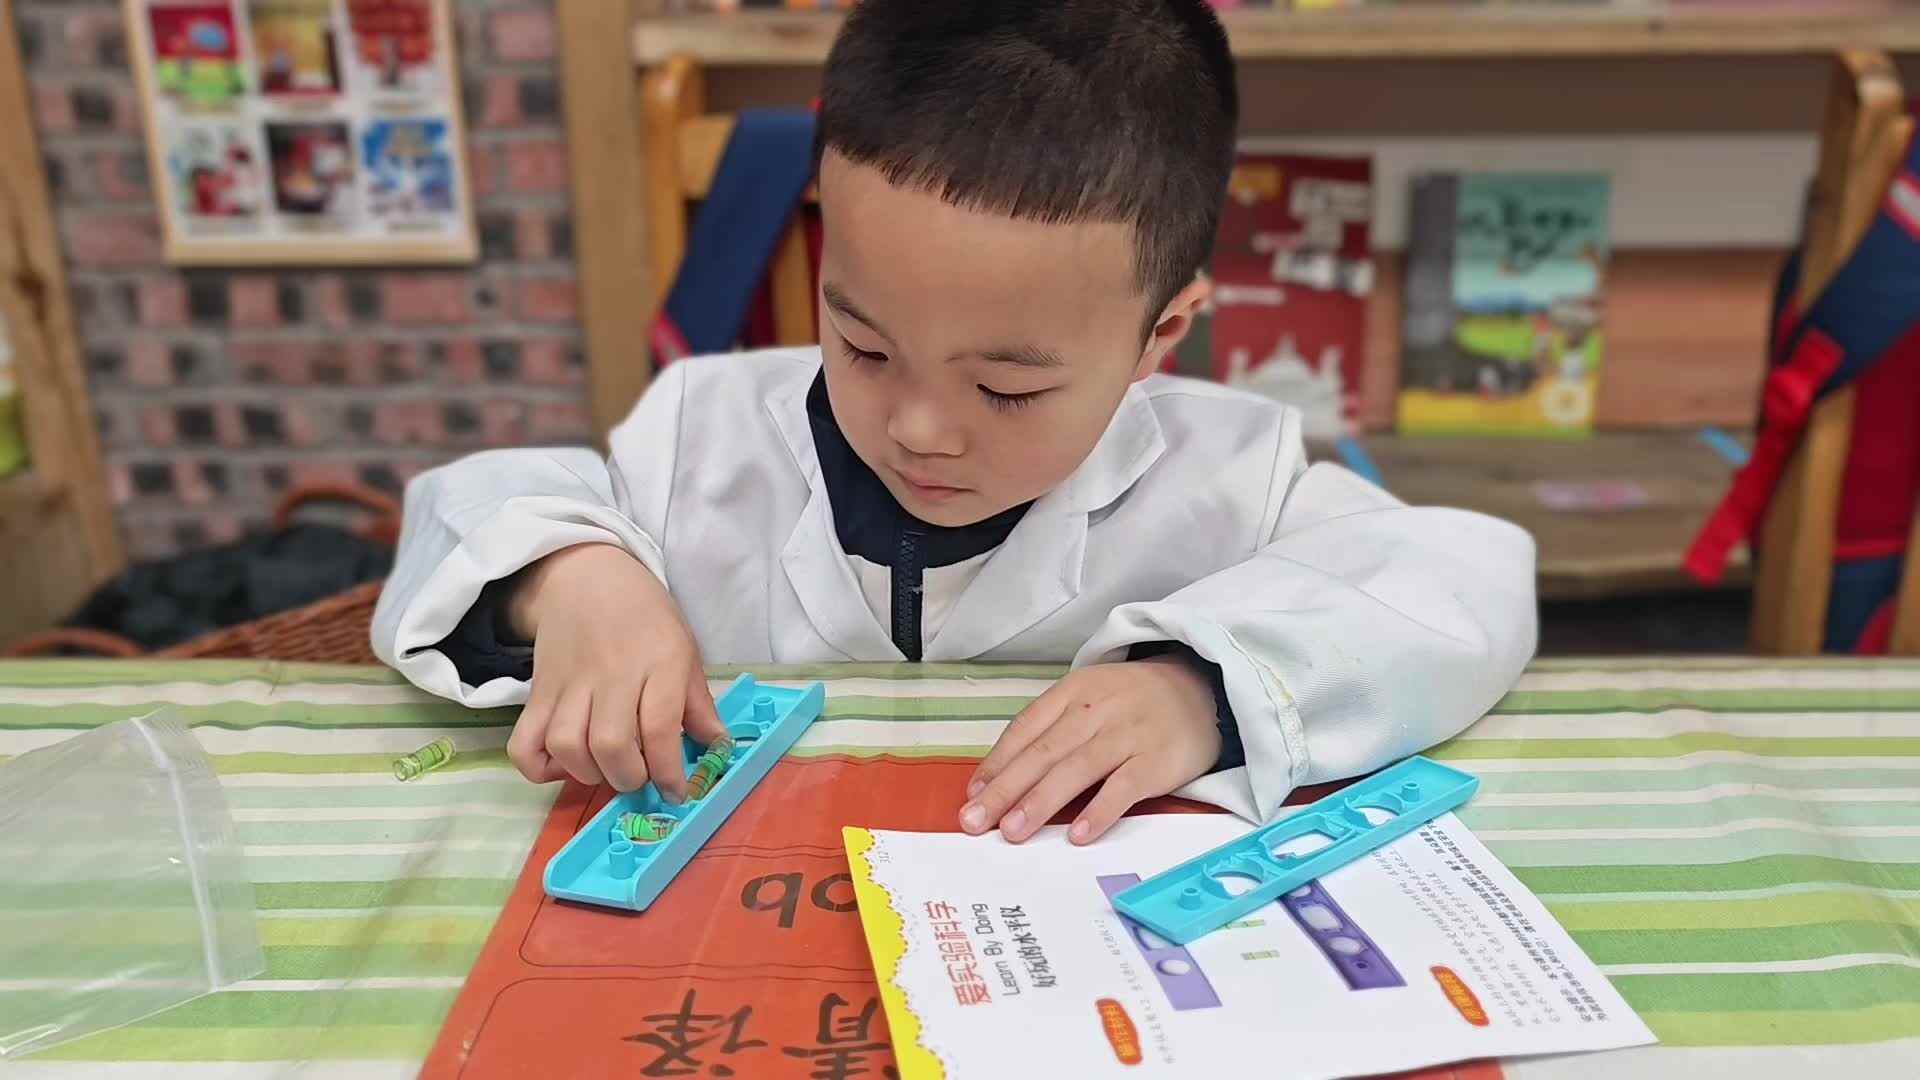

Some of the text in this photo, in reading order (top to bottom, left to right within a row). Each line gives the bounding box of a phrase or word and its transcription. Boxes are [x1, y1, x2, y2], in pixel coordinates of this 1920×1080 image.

[924, 900, 993, 1006] 爱实验科学
[972, 903, 1021, 996] Learn By Doing
[1000, 905, 1059, 988] 好玩的水平仪
